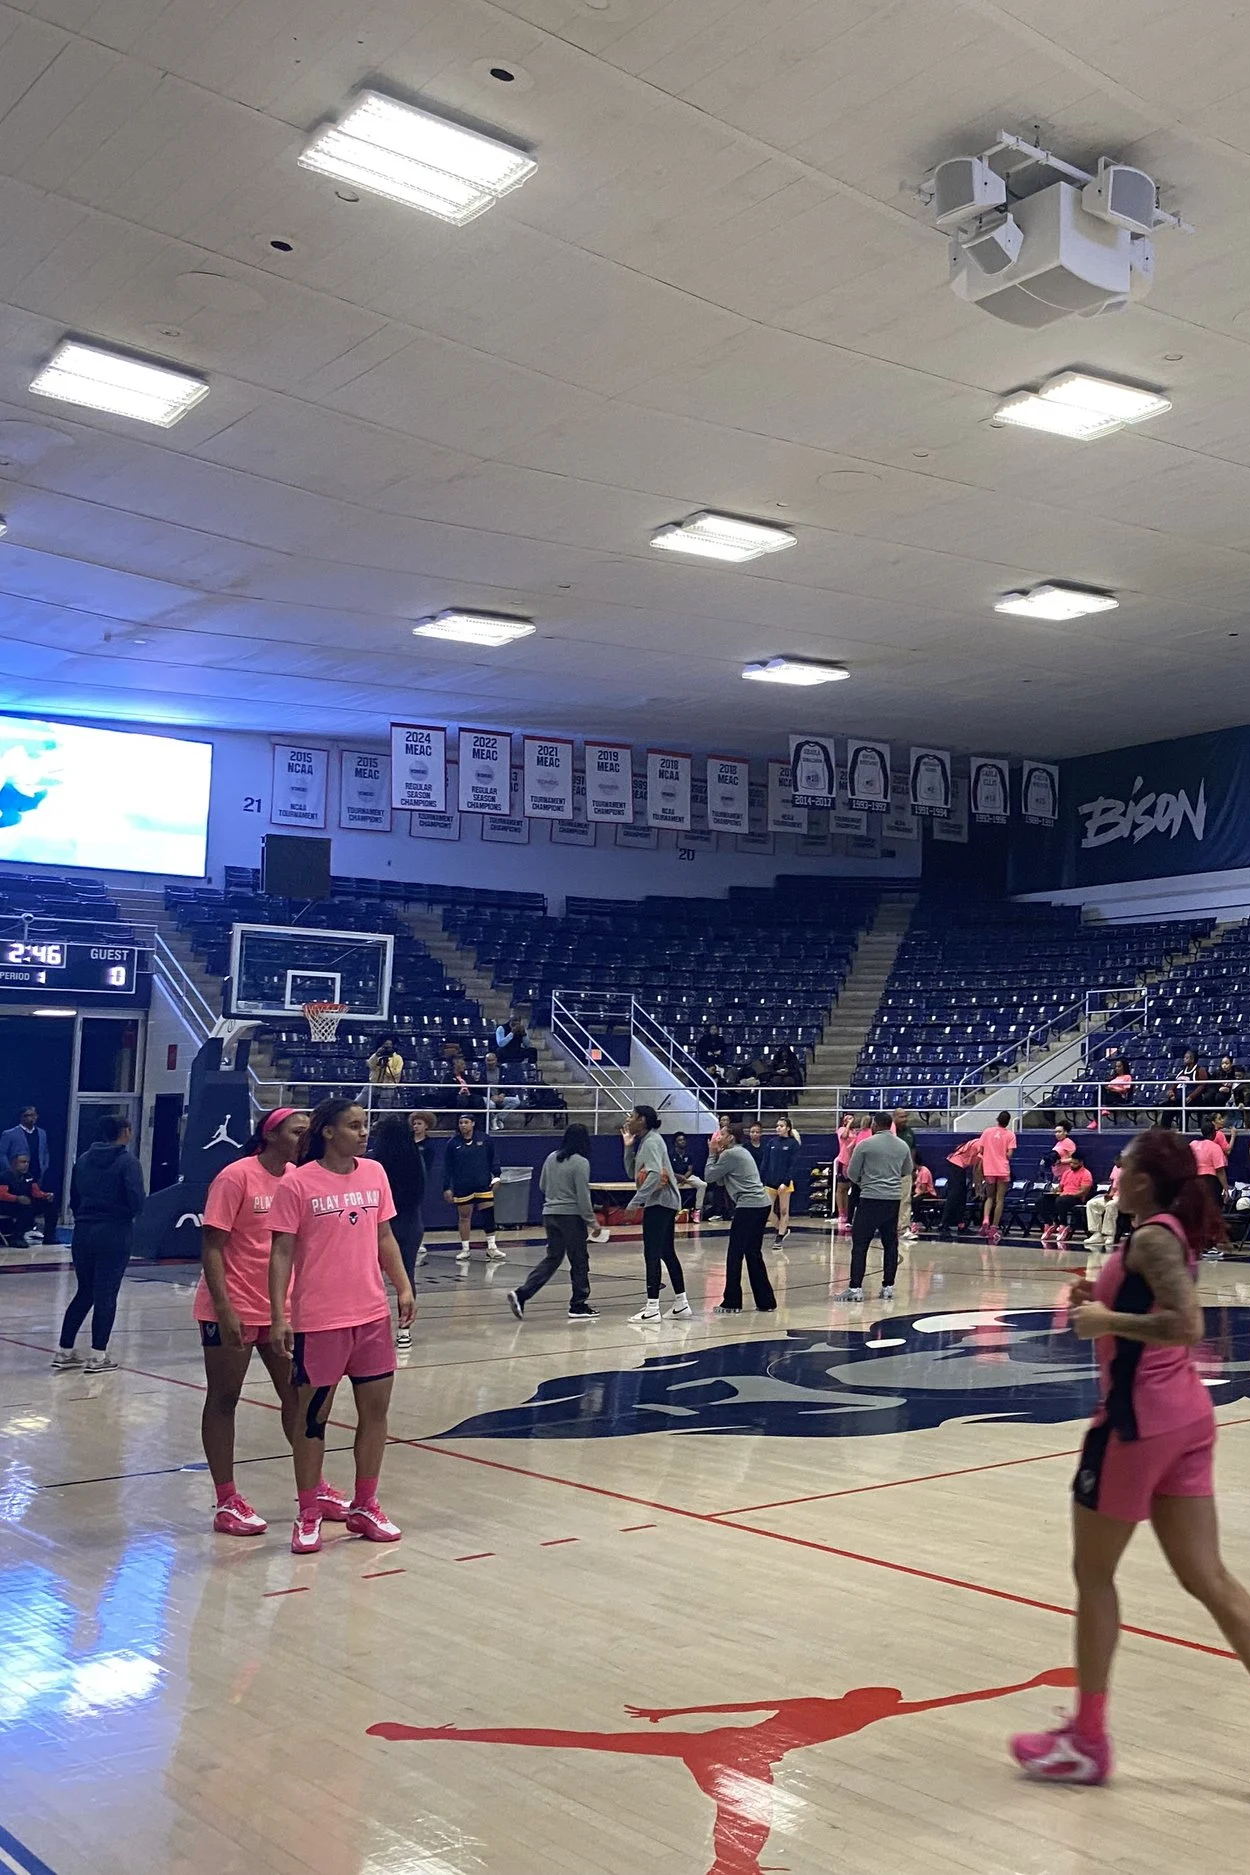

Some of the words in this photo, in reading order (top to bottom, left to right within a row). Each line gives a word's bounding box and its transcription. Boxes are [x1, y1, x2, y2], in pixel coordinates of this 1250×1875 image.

[405, 731, 431, 744] 2024
[473, 736, 497, 749] 2022
[405, 743, 432, 756] MEAC
[472, 748, 498, 761] MEAC
[537, 745, 558, 757] 2021
[597, 750, 619, 761] 2019
[290, 751, 312, 763] 2015
[356, 756, 378, 768] 2015
[536, 756, 560, 768] MEAC
[287, 762, 313, 775] NCAA
[597, 762, 620, 773] MEAC
[660, 758, 679, 770] 2018
[354, 768, 380, 780] MEAC
[658, 769, 680, 781] NCAA
[780, 767, 792, 777] 201
[717, 774, 739, 786] MEAC
[405, 782, 432, 792] REGULAR
[471, 785, 498, 795] REGULAR
[407, 790, 431, 799] SEASON
[473, 794, 496, 803] SEASON
[530, 795, 566, 805] TOURNAMENT
[243, 797, 262, 813] 21
[400, 798, 437, 808] CHAMPIONS
[466, 802, 502, 811] CHAMPIONS
[592, 800, 626, 809] TOURNAMENT
[794, 795, 832, 807] 2014-2017
[347, 806, 384, 816] TOURNAMENT
[532, 803, 565, 812] CHAMPIONS
[593, 807, 625, 816] CHAMPIONS
[279, 809, 318, 820] TOURNAMENT
[348, 814, 383, 823] CHAMPIONS
[678, 848, 696, 861] 20
[8, 943, 62, 965] 2:46
[90, 948, 130, 961] GUEST
[0, 972, 31, 981] PERIOD
[254, 1195, 275, 1210] PLAY
[311, 1194, 340, 1213] PLAY
[343, 1191, 365, 1207] FOR
